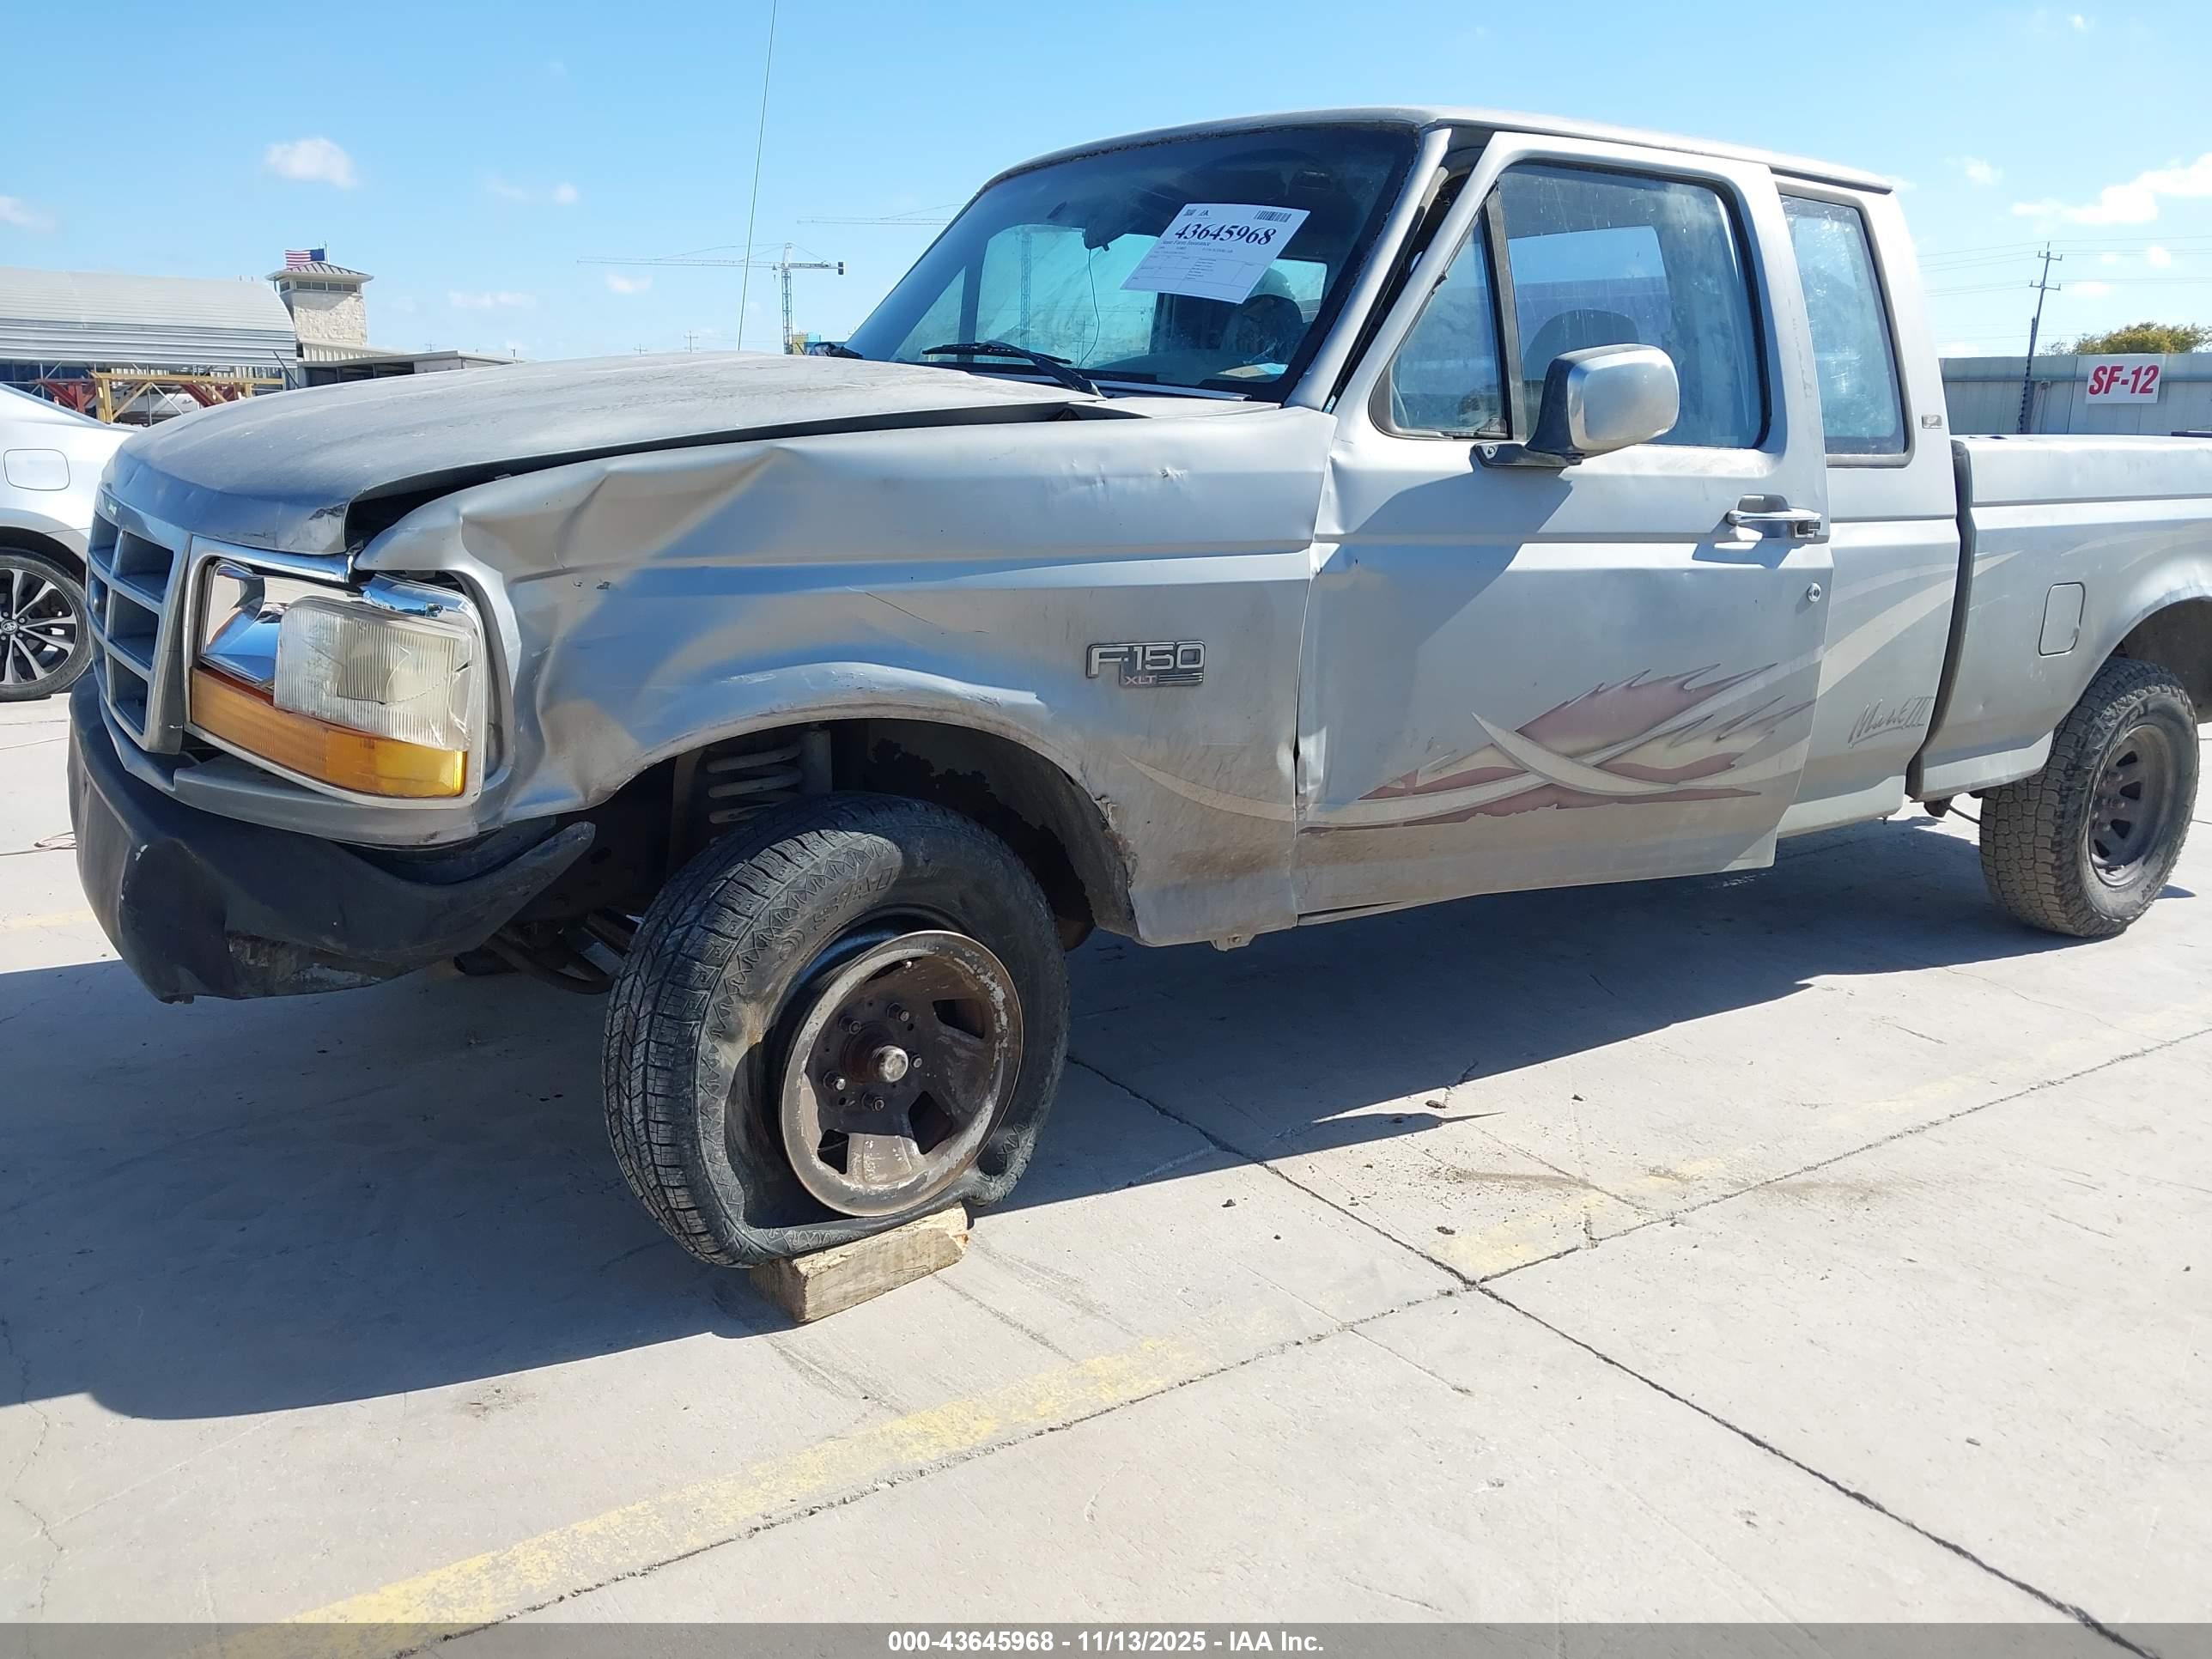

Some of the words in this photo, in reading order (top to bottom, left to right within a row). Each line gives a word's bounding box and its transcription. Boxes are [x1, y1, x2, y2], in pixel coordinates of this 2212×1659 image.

[1175, 222, 1277, 246] 43645968
[2088, 365, 2160, 395] SF-12
[1125, 675, 1157, 685] XLT
